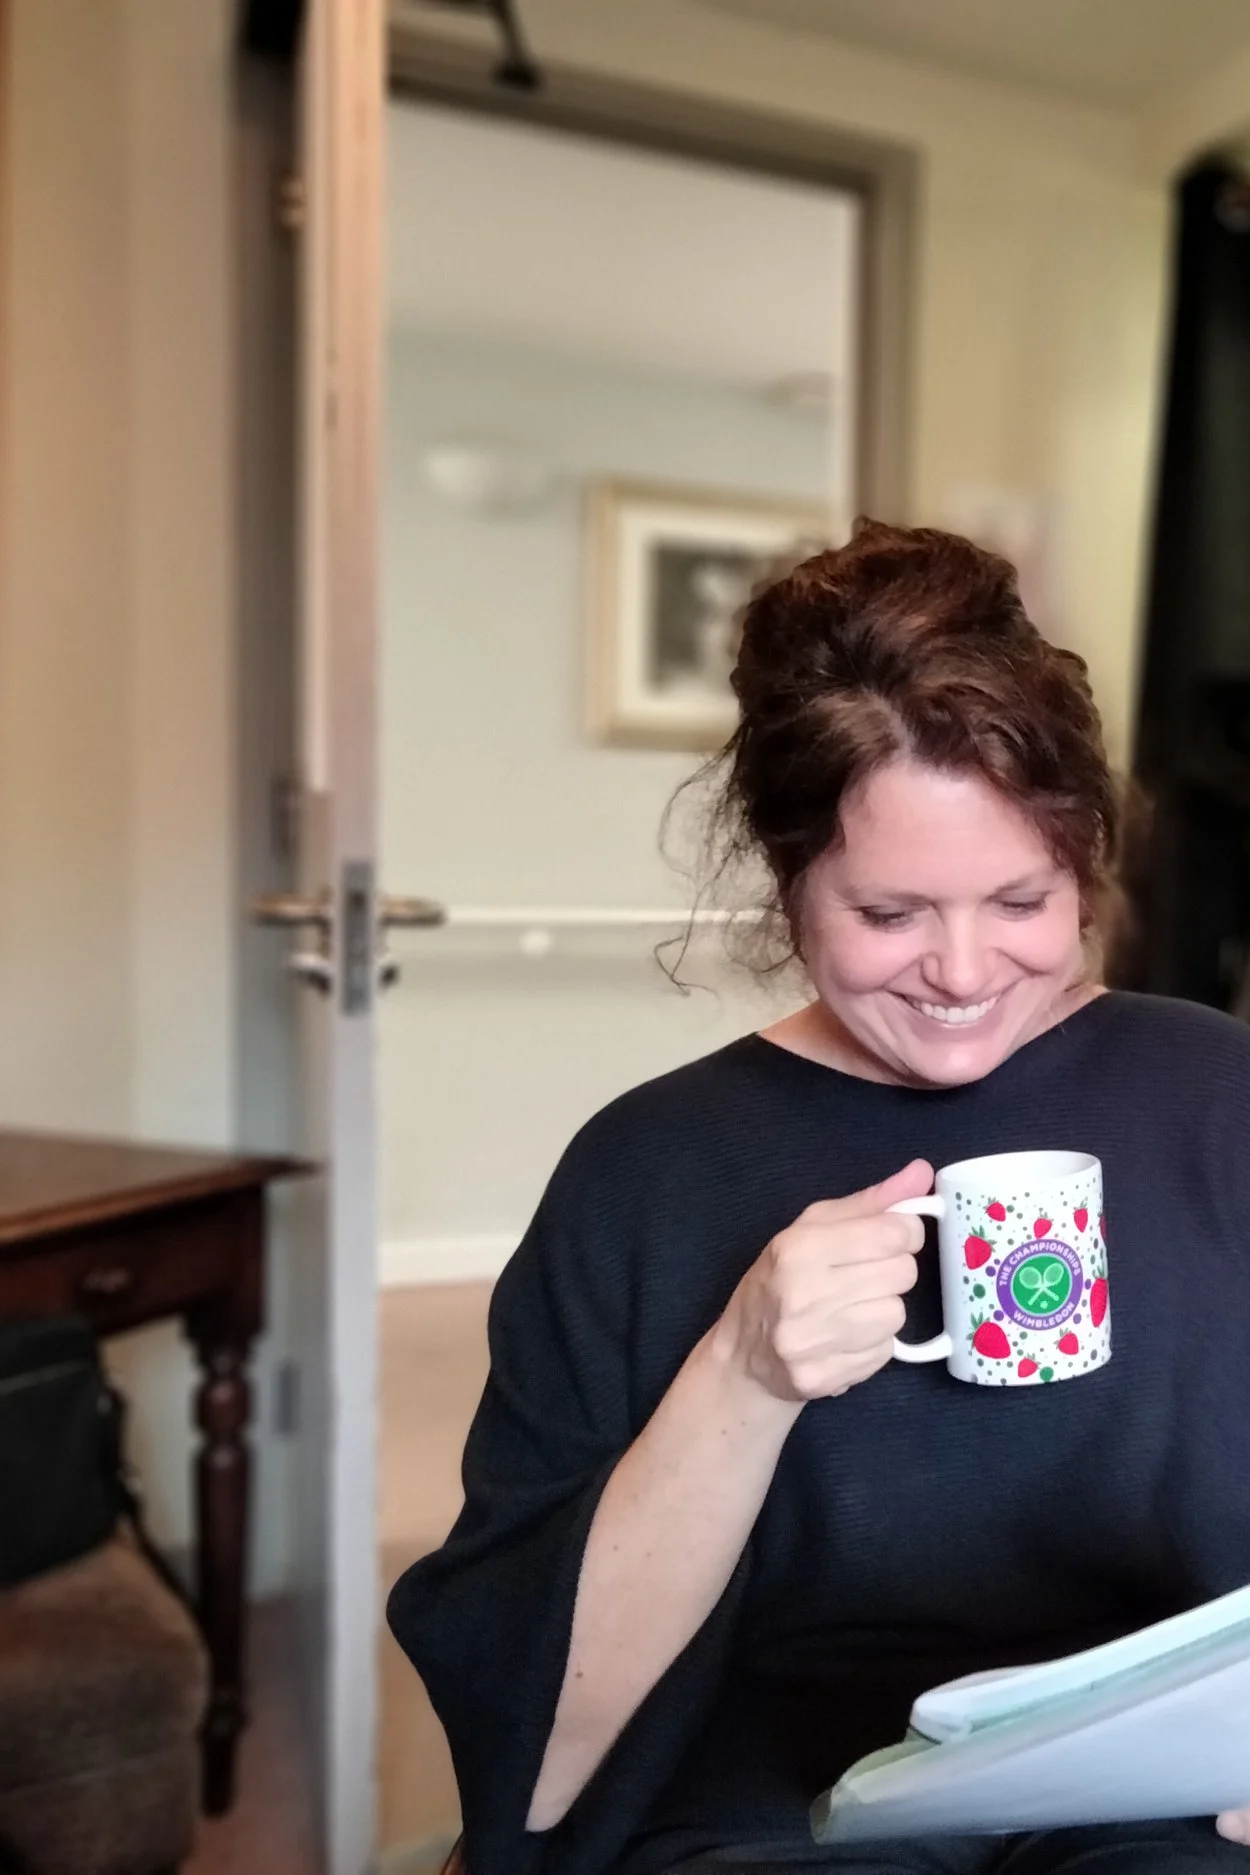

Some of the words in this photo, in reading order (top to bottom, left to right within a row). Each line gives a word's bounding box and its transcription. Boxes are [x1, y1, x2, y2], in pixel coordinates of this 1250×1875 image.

[999, 1265, 1012, 1286] THE
[1009, 1241, 1081, 1276] CHAMPIONSHIPS
[1013, 1303, 1075, 1328] WIMBLEDON
